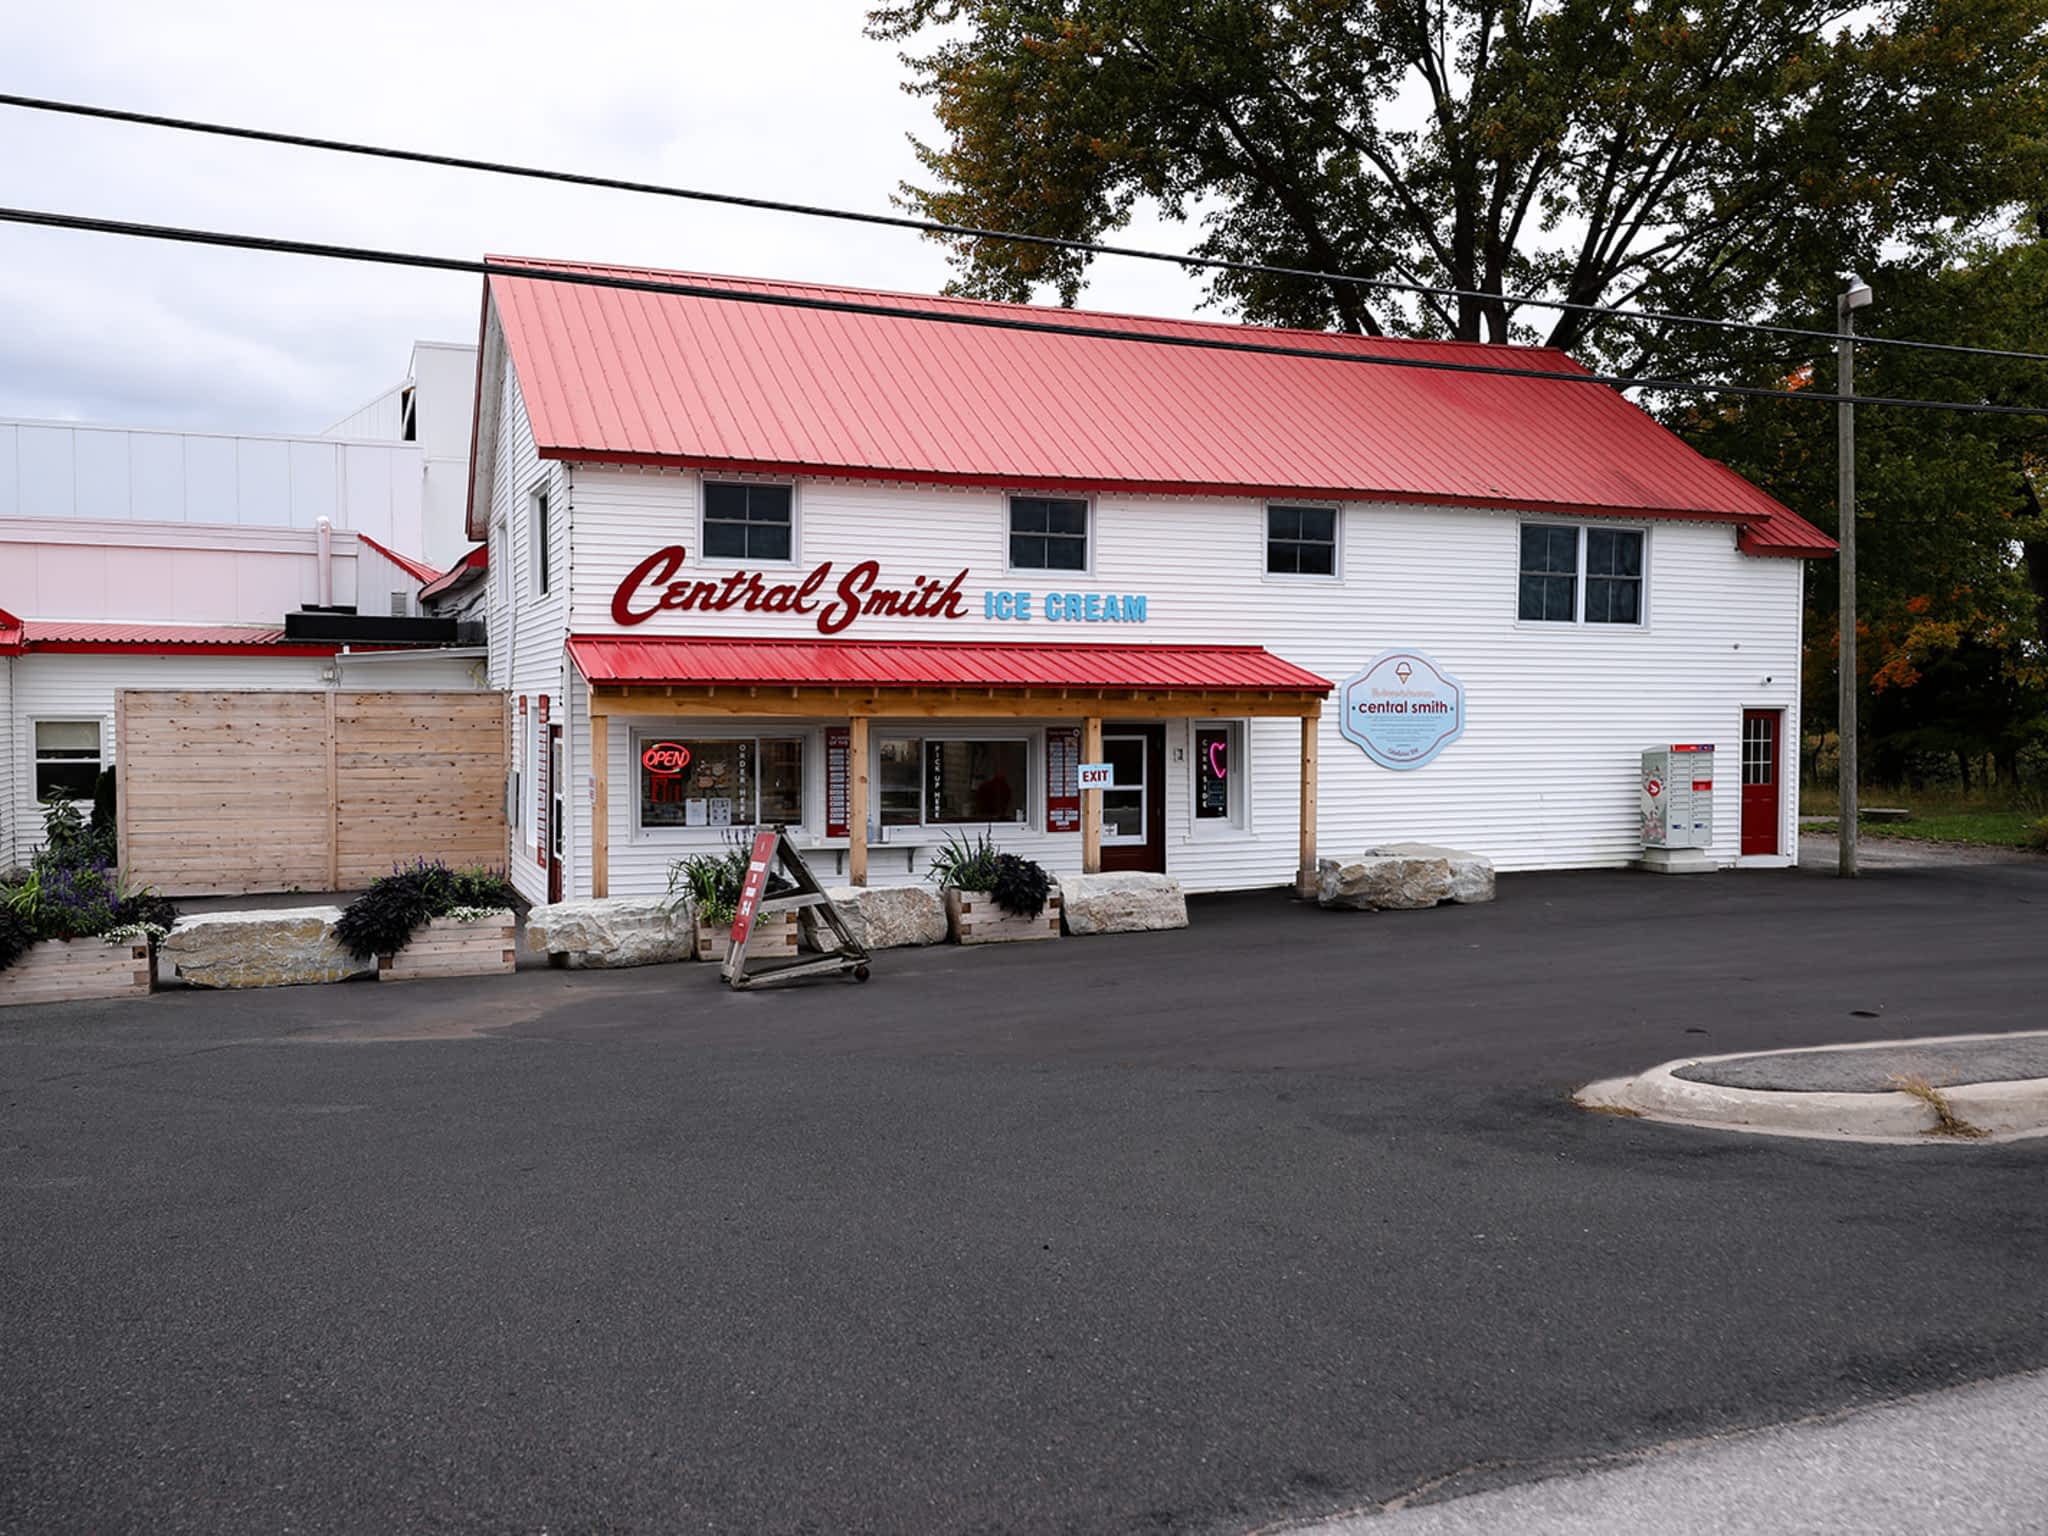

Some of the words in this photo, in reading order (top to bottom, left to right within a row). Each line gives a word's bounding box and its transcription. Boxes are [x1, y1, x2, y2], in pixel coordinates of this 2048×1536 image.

[611, 544, 832, 627] Central
[817, 560, 969, 635] Smith
[984, 590, 1031, 621] ICE
[1045, 592, 1147, 623] CREAM
[1358, 700, 1408, 713] central
[1411, 700, 1448, 713] smith
[645, 750, 686, 767] OPEN
[1082, 770, 1109, 782] EXIT
